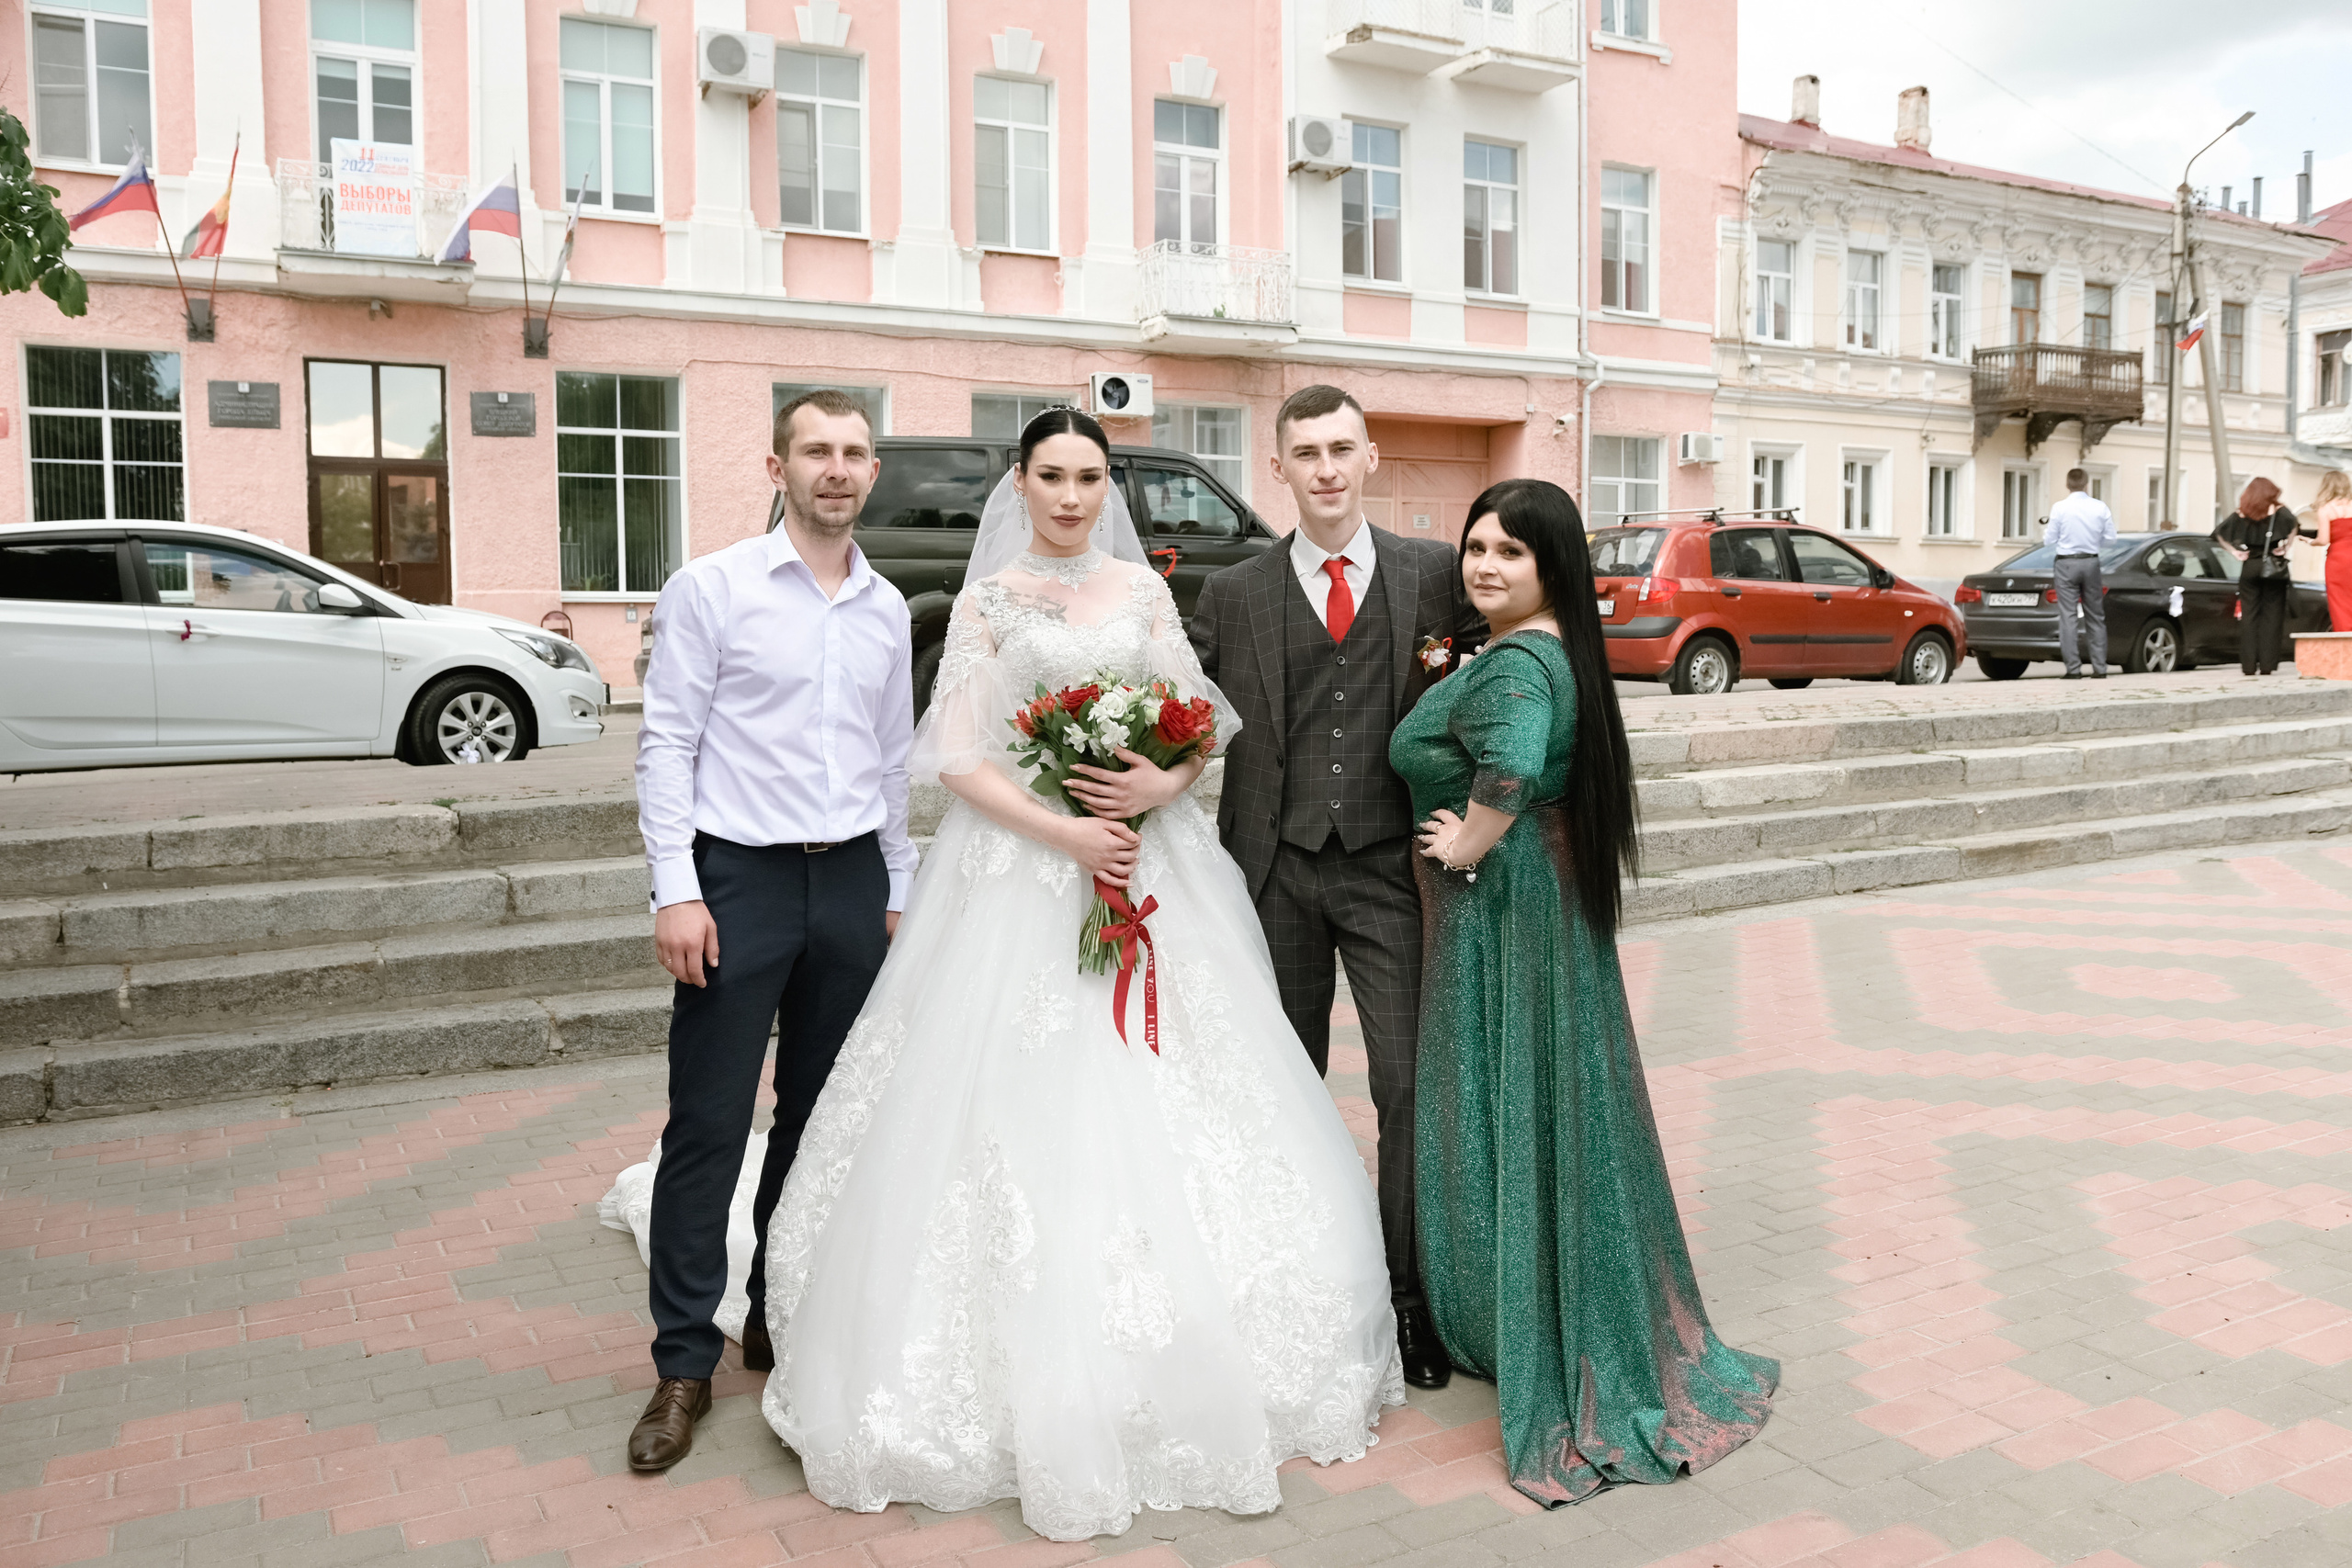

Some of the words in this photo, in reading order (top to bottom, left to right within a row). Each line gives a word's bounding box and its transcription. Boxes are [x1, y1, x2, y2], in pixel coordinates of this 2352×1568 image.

[359, 148, 375, 160] 11
[341, 158, 375, 173] 2022
[340, 183, 411, 203] ВЫБОРЫ
[340, 199, 412, 215] ДЕПУТАТОВ
[1146, 976, 1155, 1003] YOU
[1147, 1023, 1156, 1045] LIKE
